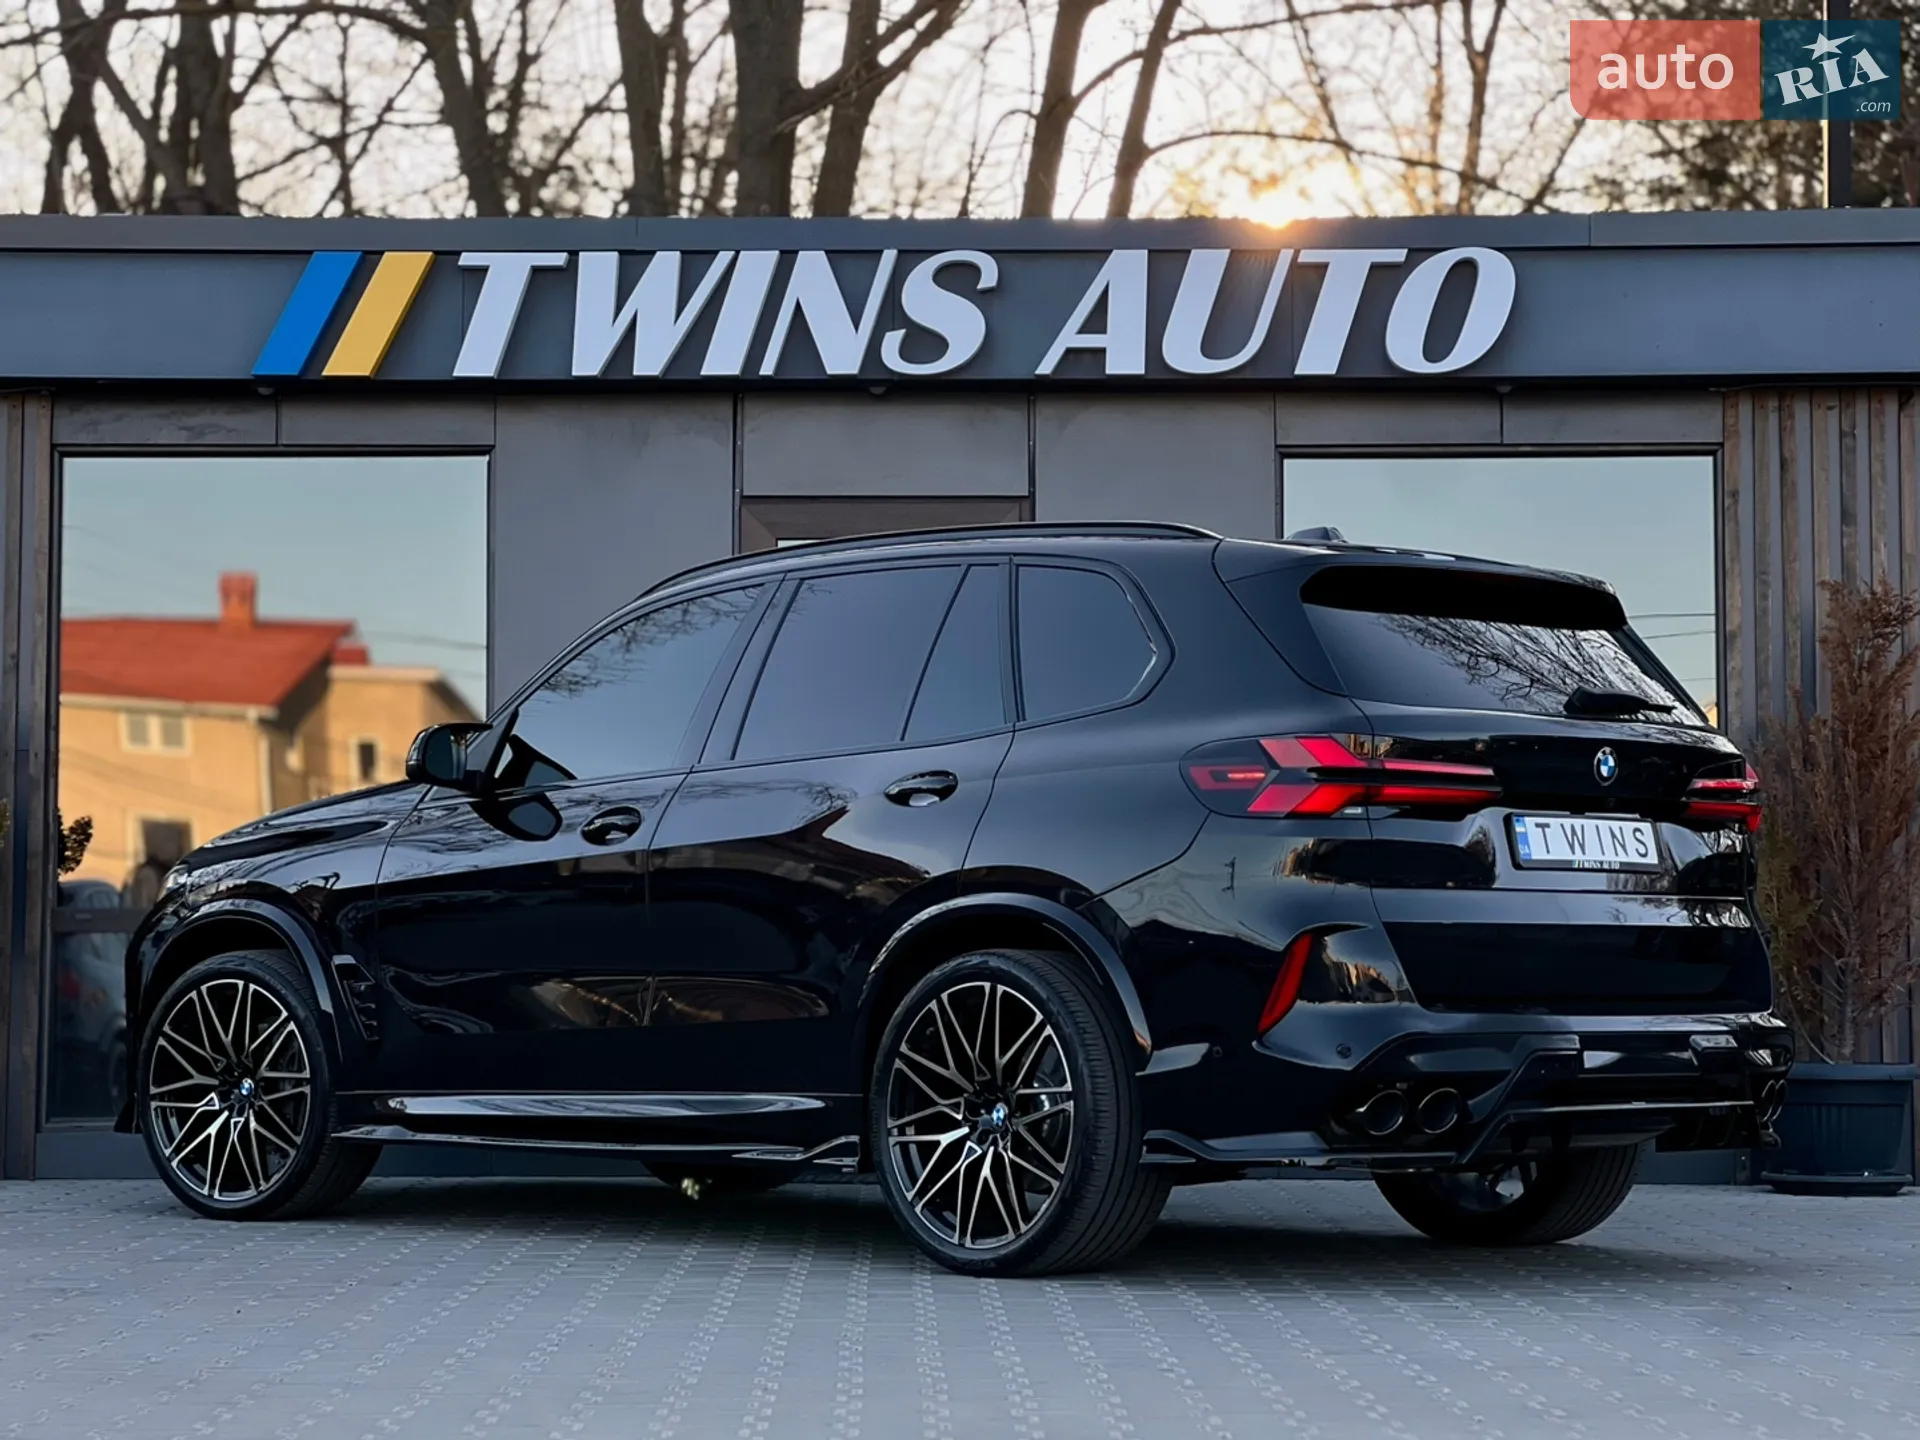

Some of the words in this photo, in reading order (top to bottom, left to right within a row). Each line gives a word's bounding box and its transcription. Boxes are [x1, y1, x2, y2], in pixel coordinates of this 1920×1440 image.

[452, 249, 999, 377] TWINS
[1034, 246, 1517, 376] AUTO
[1534, 822, 1650, 859] TWINS
